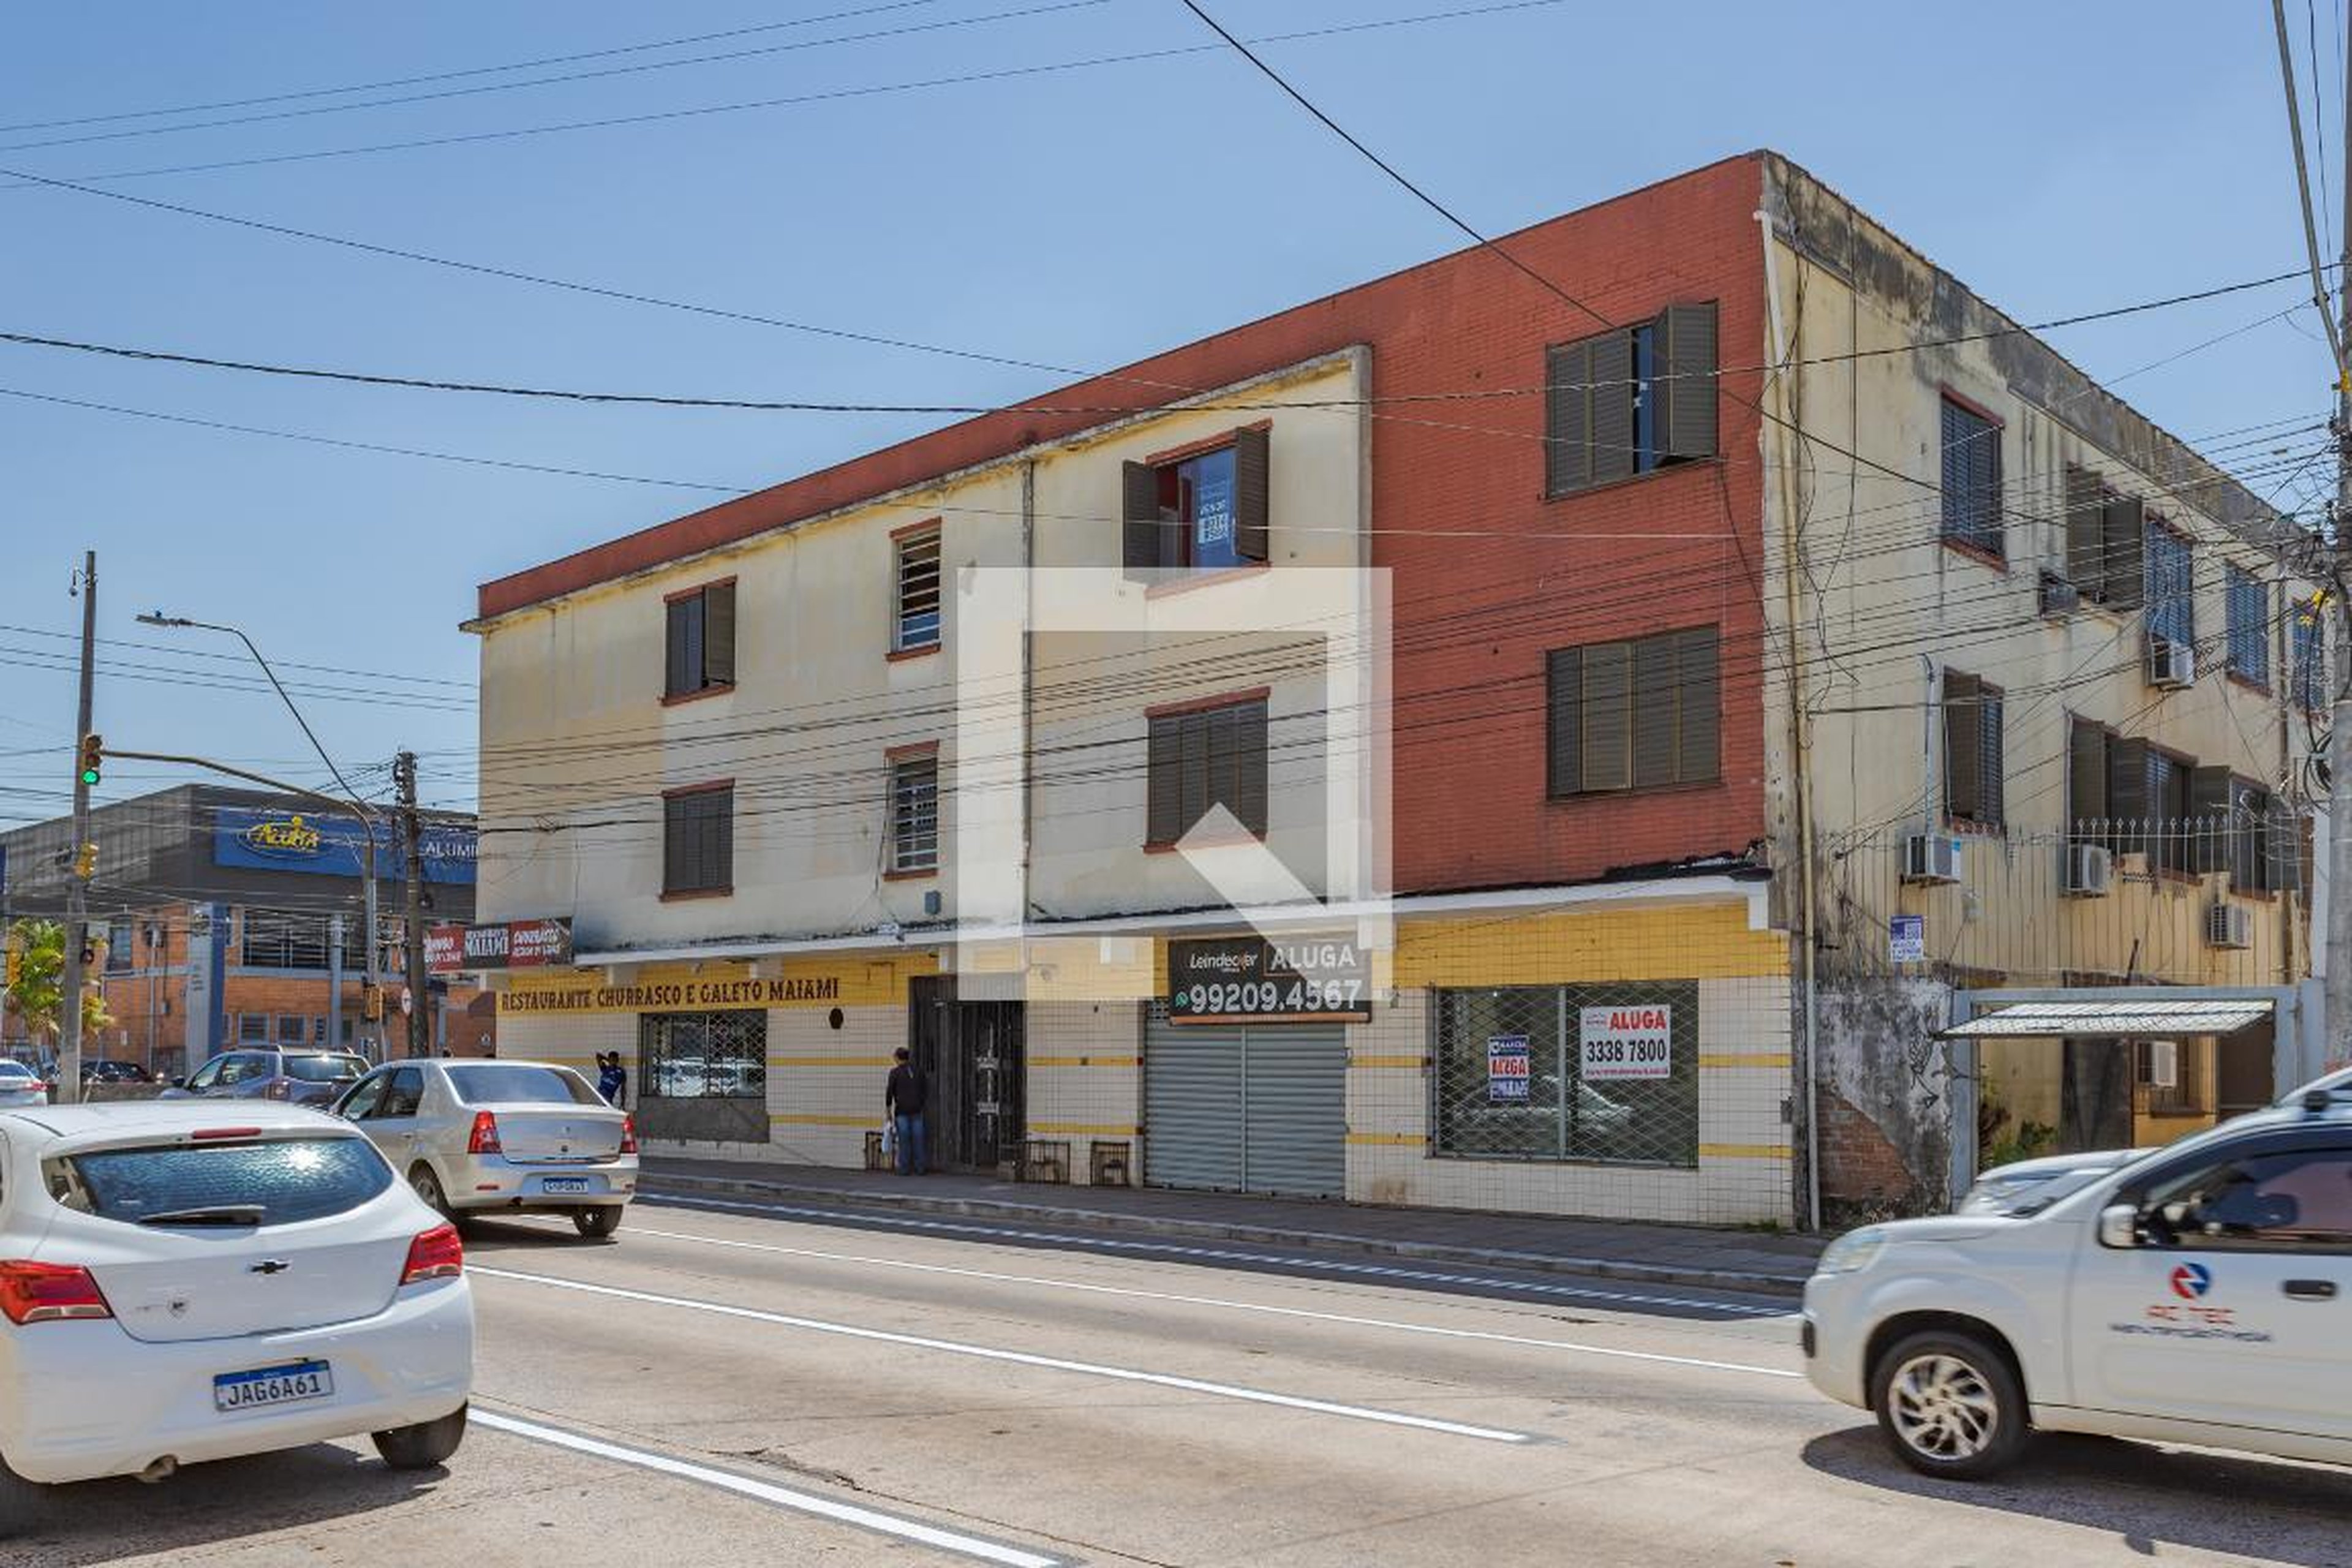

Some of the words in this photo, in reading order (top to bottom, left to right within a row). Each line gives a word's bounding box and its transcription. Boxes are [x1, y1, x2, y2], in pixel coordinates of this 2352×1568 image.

[1270, 944, 1356, 970] ALUGA
[502, 990, 590, 1011] RESTAURANTE
[597, 986, 681, 1008] CHURRASCO
[687, 984, 695, 1004] E
[700, 981, 762, 1003] GALETO
[769, 978, 839, 1001] MAIAMI
[1190, 979, 1362, 1012] 99209.4567
[1610, 1011, 1667, 1030] ALUGA
[1586, 1039, 1623, 1062] 3338
[1628, 1038, 1665, 1061] 7800
[228, 1374, 320, 1405] JAG6A61
